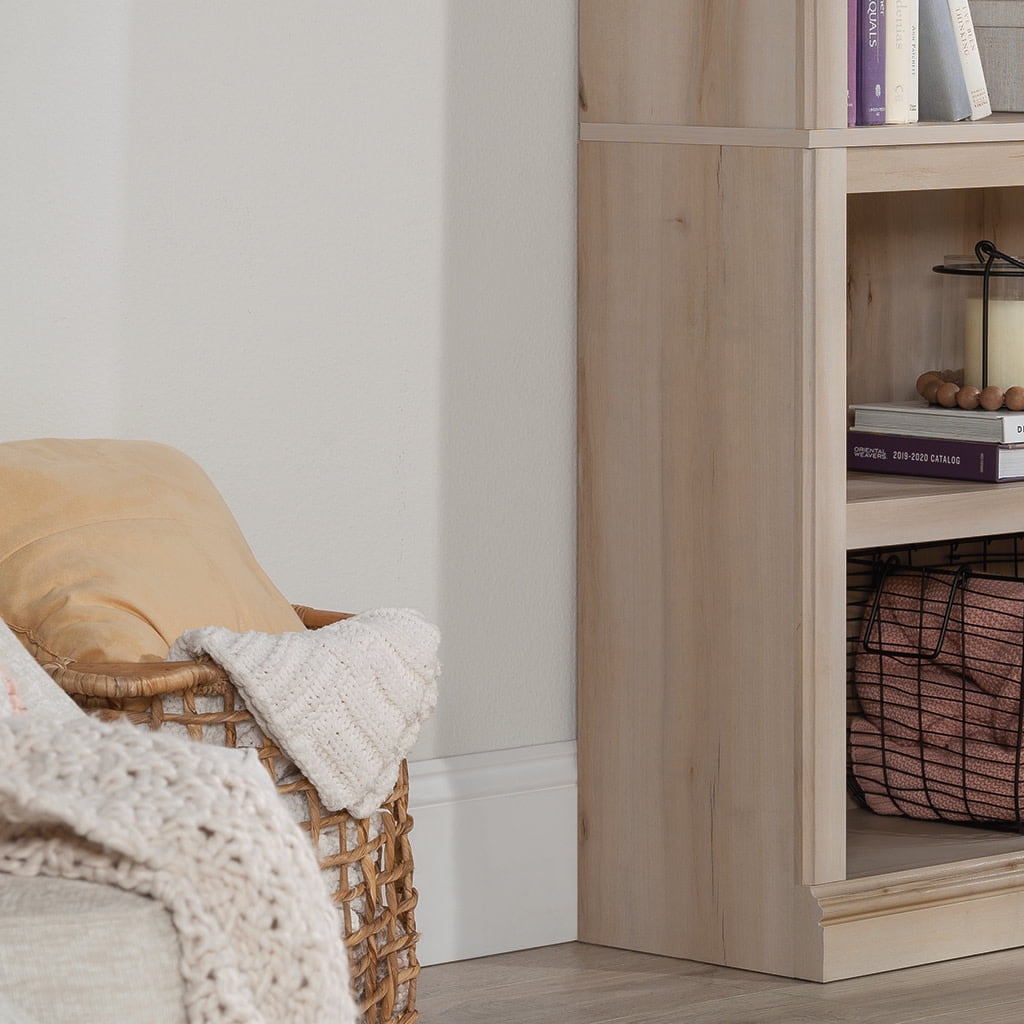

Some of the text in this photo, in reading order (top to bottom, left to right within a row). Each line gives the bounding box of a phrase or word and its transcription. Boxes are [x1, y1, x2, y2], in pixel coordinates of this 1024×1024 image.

[955, 8, 969, 56] THINKING
[853, 446, 886, 454] ORIENTAL
[853, 452, 887, 460] WEAVERS
[892, 450, 961, 465] 2019-2020 CATALOG
